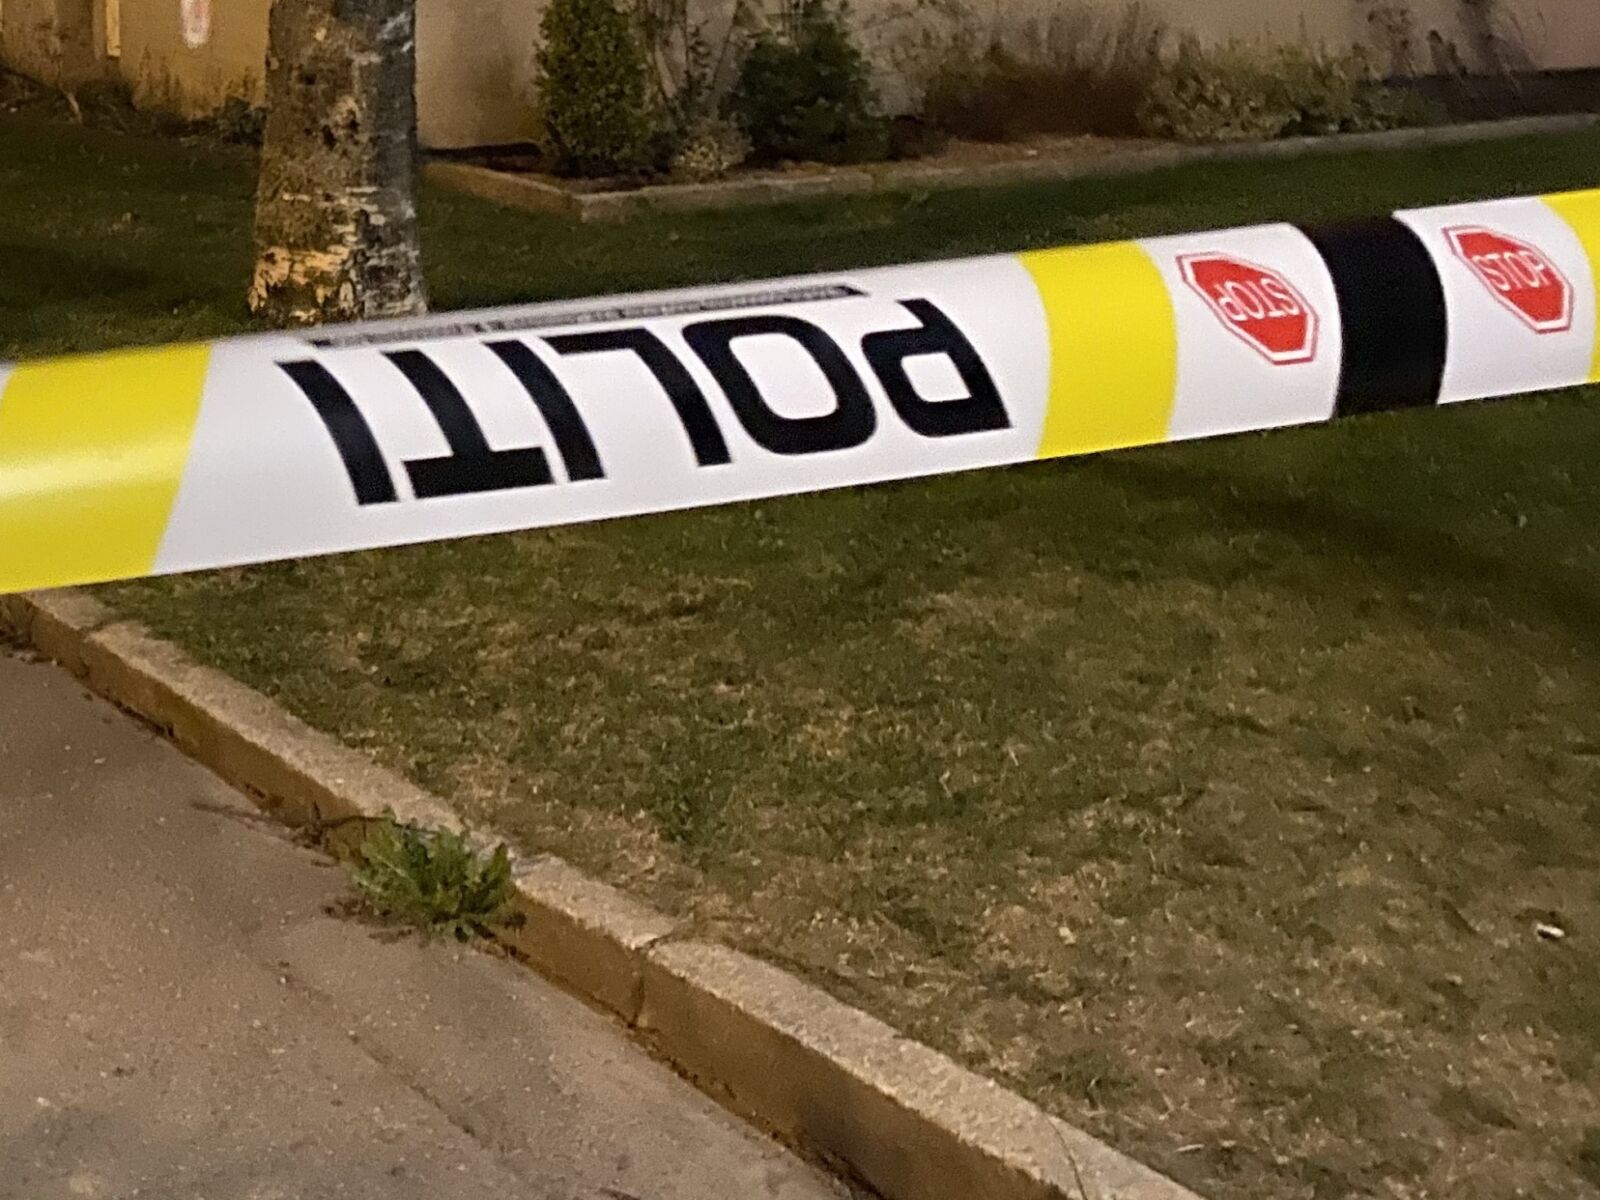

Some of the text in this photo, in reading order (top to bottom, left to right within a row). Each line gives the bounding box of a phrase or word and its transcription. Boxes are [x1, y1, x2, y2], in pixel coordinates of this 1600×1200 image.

[1470, 251, 1546, 292] STOP
[1213, 277, 1299, 321] STOP
[274, 298, 1013, 506] POLITI
